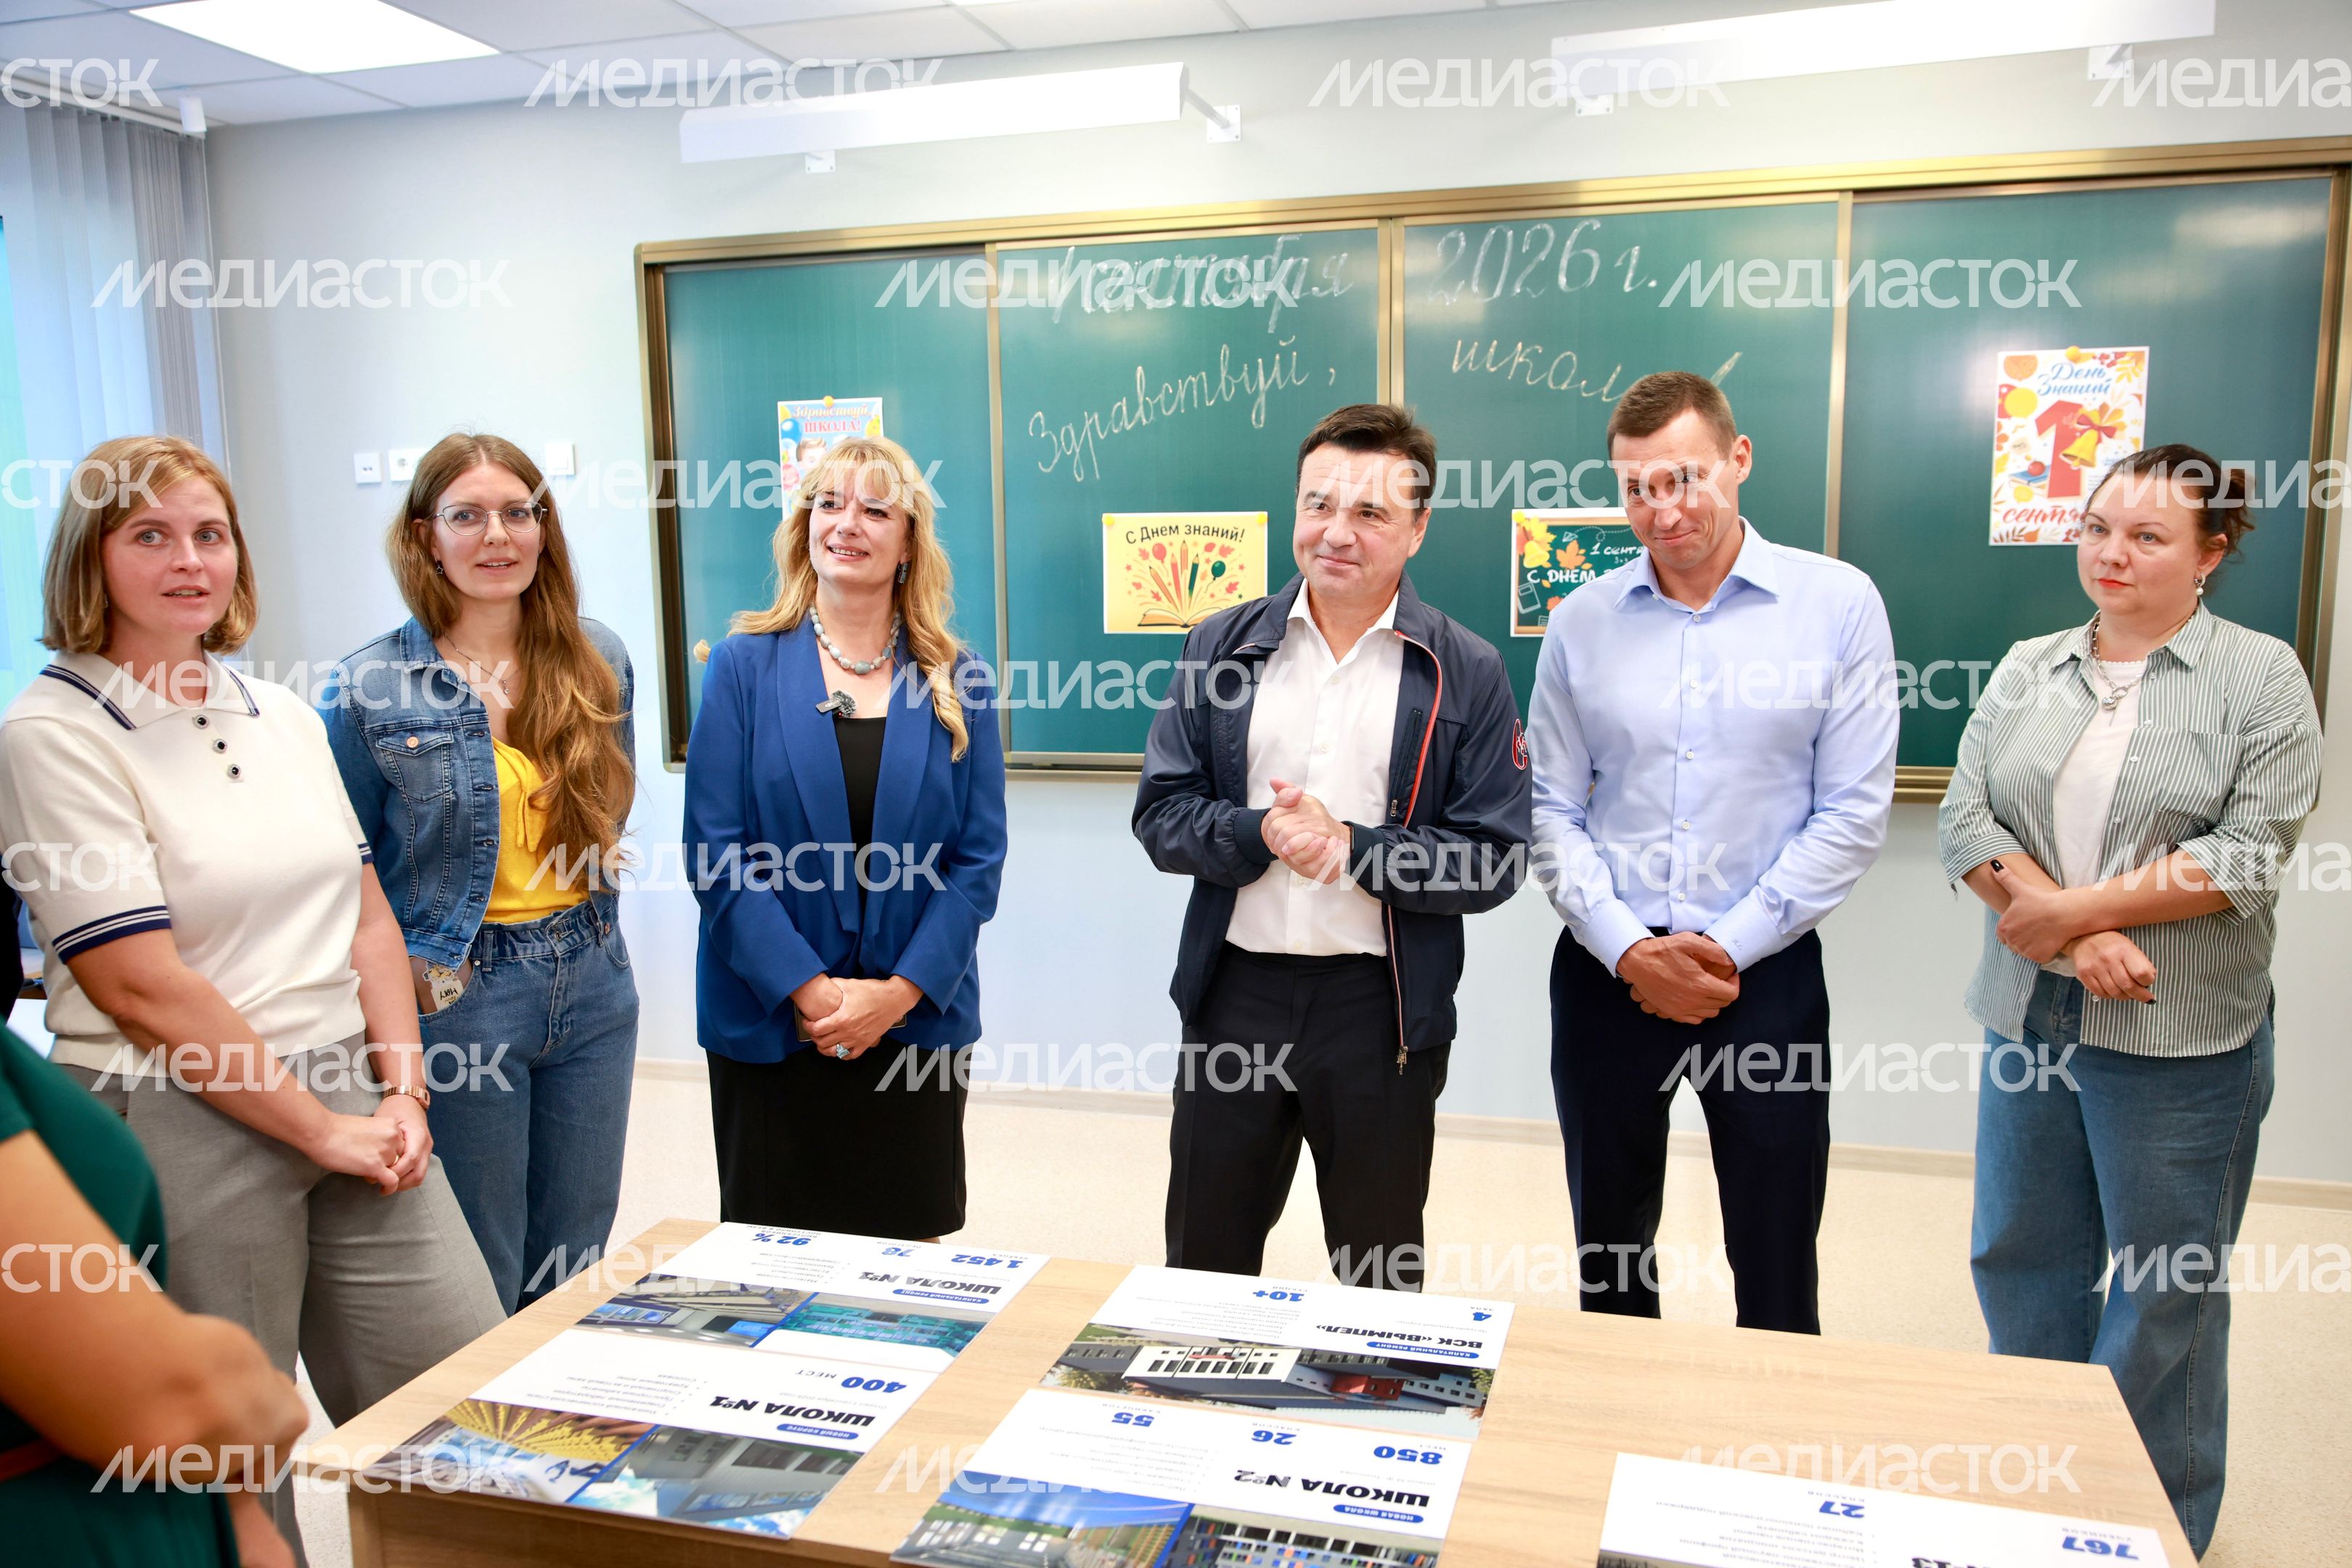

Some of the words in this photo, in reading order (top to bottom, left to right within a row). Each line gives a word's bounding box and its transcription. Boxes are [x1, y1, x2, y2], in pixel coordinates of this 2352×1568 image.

[1427, 219, 1602, 306] 2026
[1452, 338, 1743, 401] школ
[2051, 362, 2106, 380] День
[2037, 374, 2113, 397] Знаний
[804, 420, 861, 433] ШКОЛА!
[2003, 505, 2082, 525] сентя
[1125, 531, 1137, 544] С
[1140, 524, 1180, 543] Днем
[1183, 524, 1246, 543] знаний!
[1590, 542, 1601, 555] 1
[1527, 569, 1540, 584] С
[1546, 568, 1597, 584] ДНЕМ
[751, 1233, 775, 1242] %
[777, 1236, 812, 1246] 92
[881, 1246, 915, 1257] 78
[950, 1254, 1003, 1267] 452
[857, 1271, 901, 1283] №1
[899, 1289, 929, 1298] РЕМОНТ
[906, 1276, 1003, 1295] ШКОЛА
[929, 1292, 982, 1304] КАПИТАЛЬНЫЙ
[1252, 1290, 1305, 1302] 10+
[1472, 1311, 1493, 1321] 4
[1315, 1324, 1432, 1342] «ВЫМПЕЛ»
[1436, 1337, 1484, 1349] ВСК
[1410, 1347, 1471, 1357] КАПИТАЛЬНЫЙ
[794, 1369, 838, 1379] МЕСТ
[841, 1376, 907, 1394] 400
[709, 1396, 759, 1411] №1
[764, 1402, 876, 1427] ШКОЛА
[1111, 1412, 1155, 1428] 55
[1251, 1429, 1297, 1446] 26
[1373, 1446, 1443, 1465] 850
[1233, 1470, 1291, 1488] №2
[1301, 1479, 1430, 1508] ШКОЛА
[1818, 1500, 1866, 1519] 27
[2062, 1535, 2139, 1561] 767
